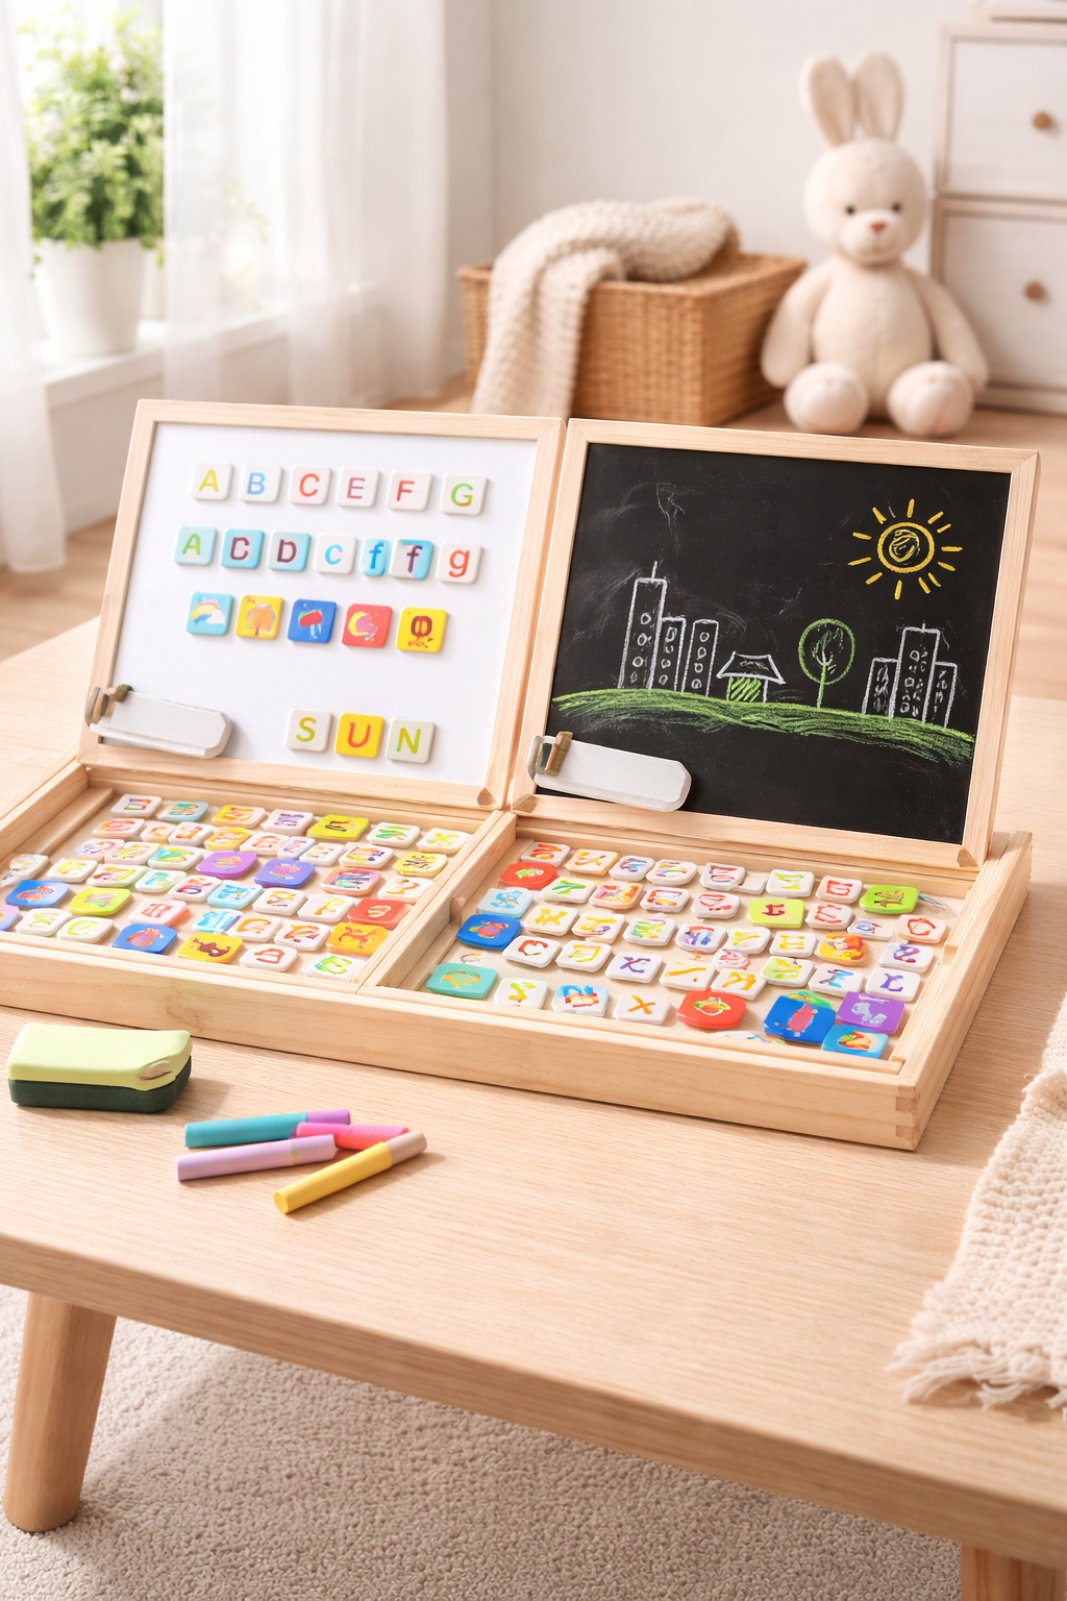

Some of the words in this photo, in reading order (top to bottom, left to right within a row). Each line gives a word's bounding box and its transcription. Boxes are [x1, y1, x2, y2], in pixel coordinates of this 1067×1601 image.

[198, 469, 219, 493] A
[246, 472, 266, 495] B
[299, 472, 320, 497] C
[346, 477, 366, 500] E
[396, 480, 415, 502] F
[450, 483, 474, 508] G
[182, 533, 202, 557] A
[369, 541, 385, 570] f
[406, 544, 423, 573] f
[448, 549, 470, 578] g
